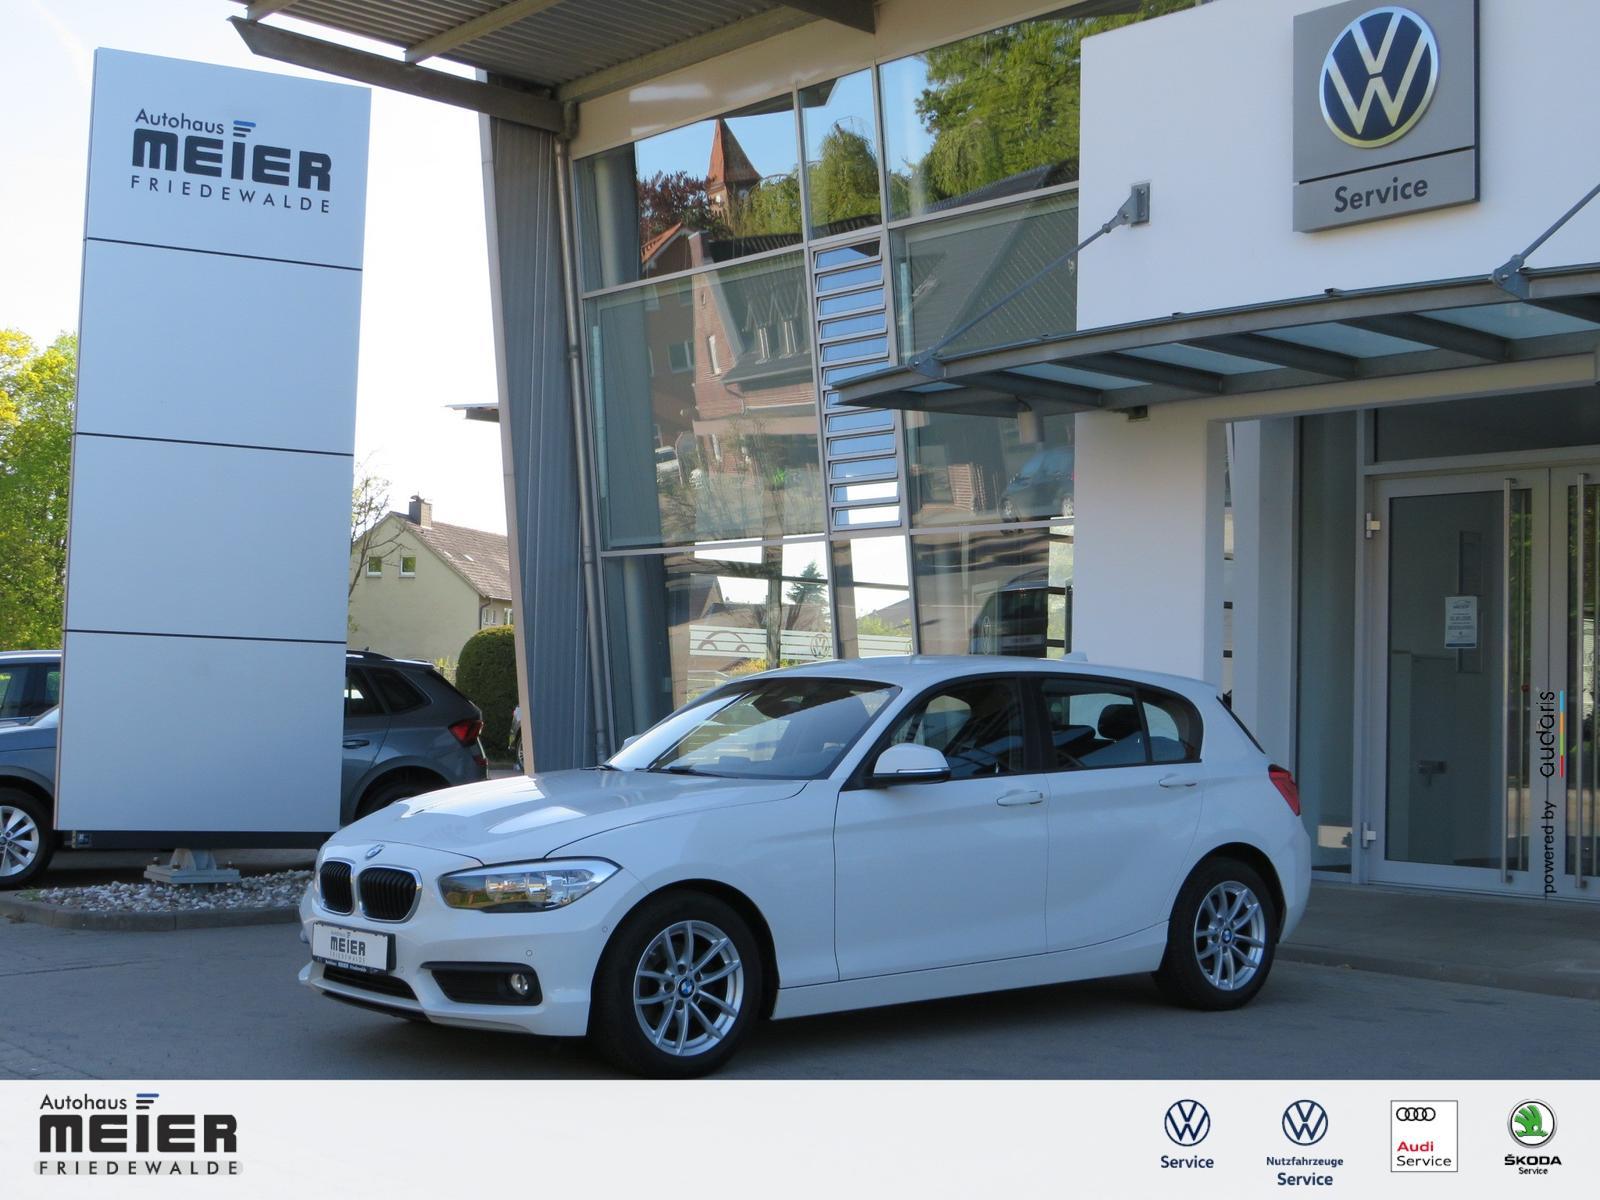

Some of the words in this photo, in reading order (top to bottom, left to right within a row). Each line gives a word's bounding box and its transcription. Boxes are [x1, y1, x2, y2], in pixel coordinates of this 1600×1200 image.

[135, 108, 224, 135] Autohaus
[132, 126, 332, 192] MEIER
[131, 175, 330, 213] FRIEDEWALDE
[1334, 177, 1429, 213] Service
[331, 936, 366, 956] MEIER
